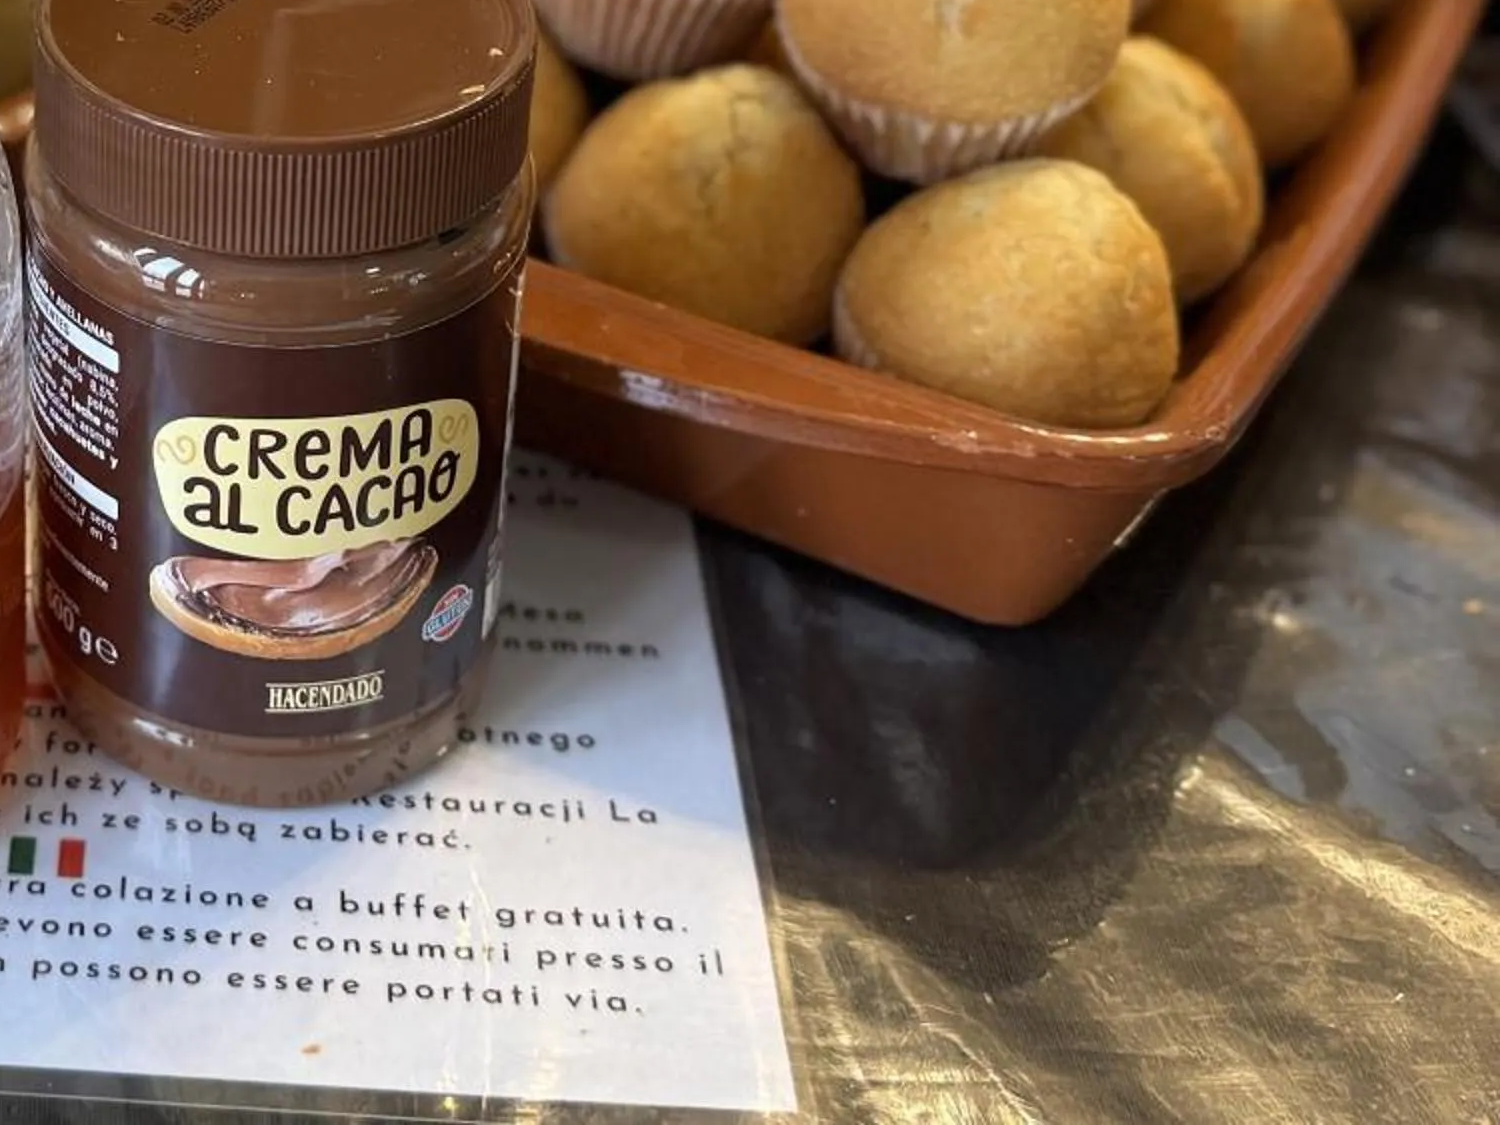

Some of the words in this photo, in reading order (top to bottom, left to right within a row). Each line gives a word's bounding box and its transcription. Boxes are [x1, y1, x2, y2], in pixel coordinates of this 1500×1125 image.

[276, 450, 461, 536] CACAO
[504, 638, 660, 658] nommen
[268, 673, 383, 710] HACENDADO
[24, 802, 78, 826] ich
[101, 812, 141, 830] ze
[165, 810, 257, 842] sobą
[280, 818, 472, 851] zabierać.
[609, 798, 658, 824] La
[70, 878, 270, 910] colazione
[292, 895, 314, 913] a
[339, 889, 470, 922] buffet
[494, 906, 689, 934] gratuita.
[135, 924, 268, 949] essere
[292, 932, 511, 965] consumati
[535, 949, 675, 974] presso
[698, 948, 724, 977] il
[31, 959, 202, 987] possono
[226, 971, 361, 996] essere
[386, 980, 540, 1008] portati
[564, 988, 643, 1014] via.
